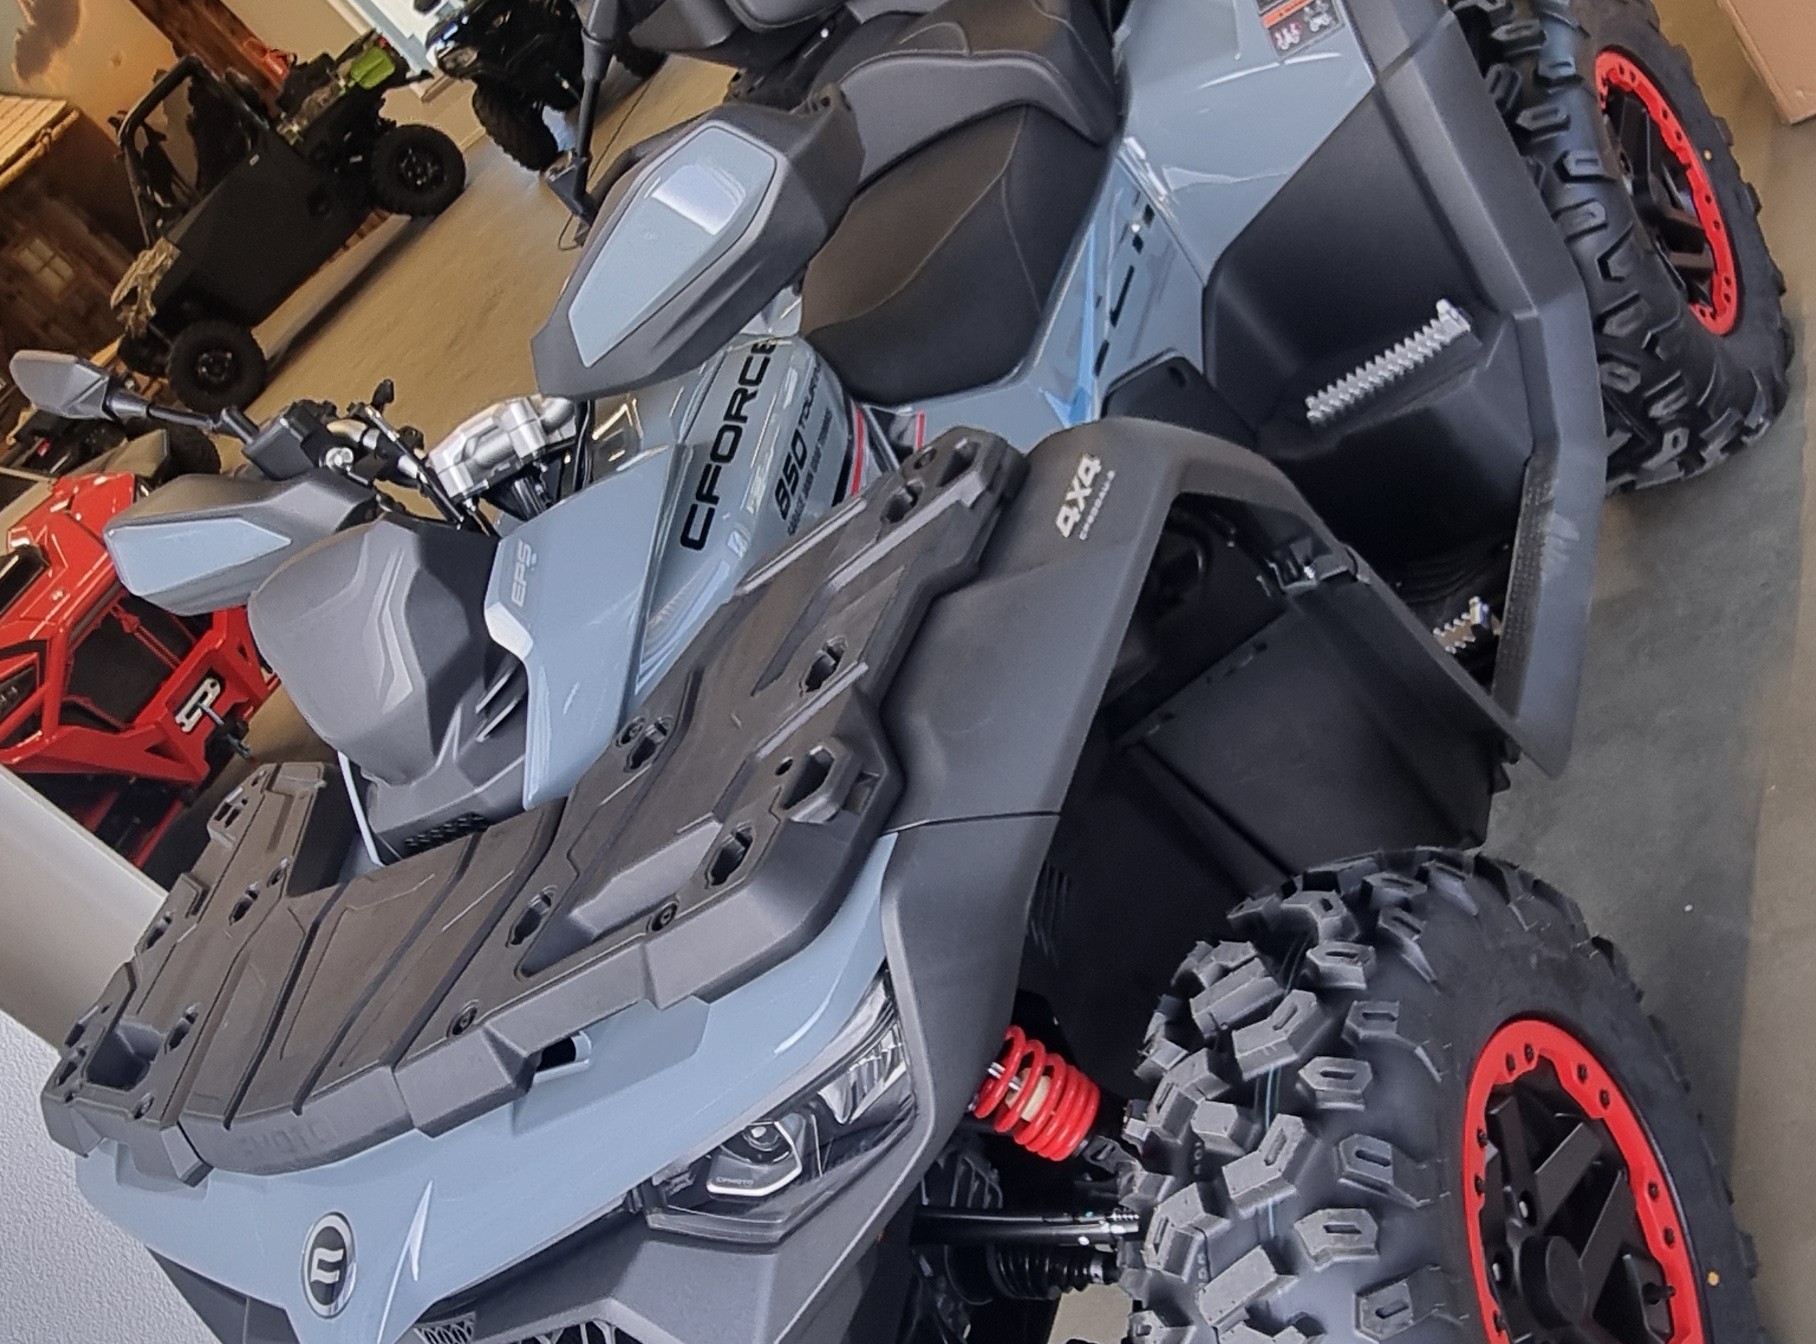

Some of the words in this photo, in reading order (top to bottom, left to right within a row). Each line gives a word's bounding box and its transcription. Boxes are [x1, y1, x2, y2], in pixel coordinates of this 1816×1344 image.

[680, 341, 778, 550] CFORCE
[775, 428, 808, 521] 850
[511, 538, 533, 608] EPS
